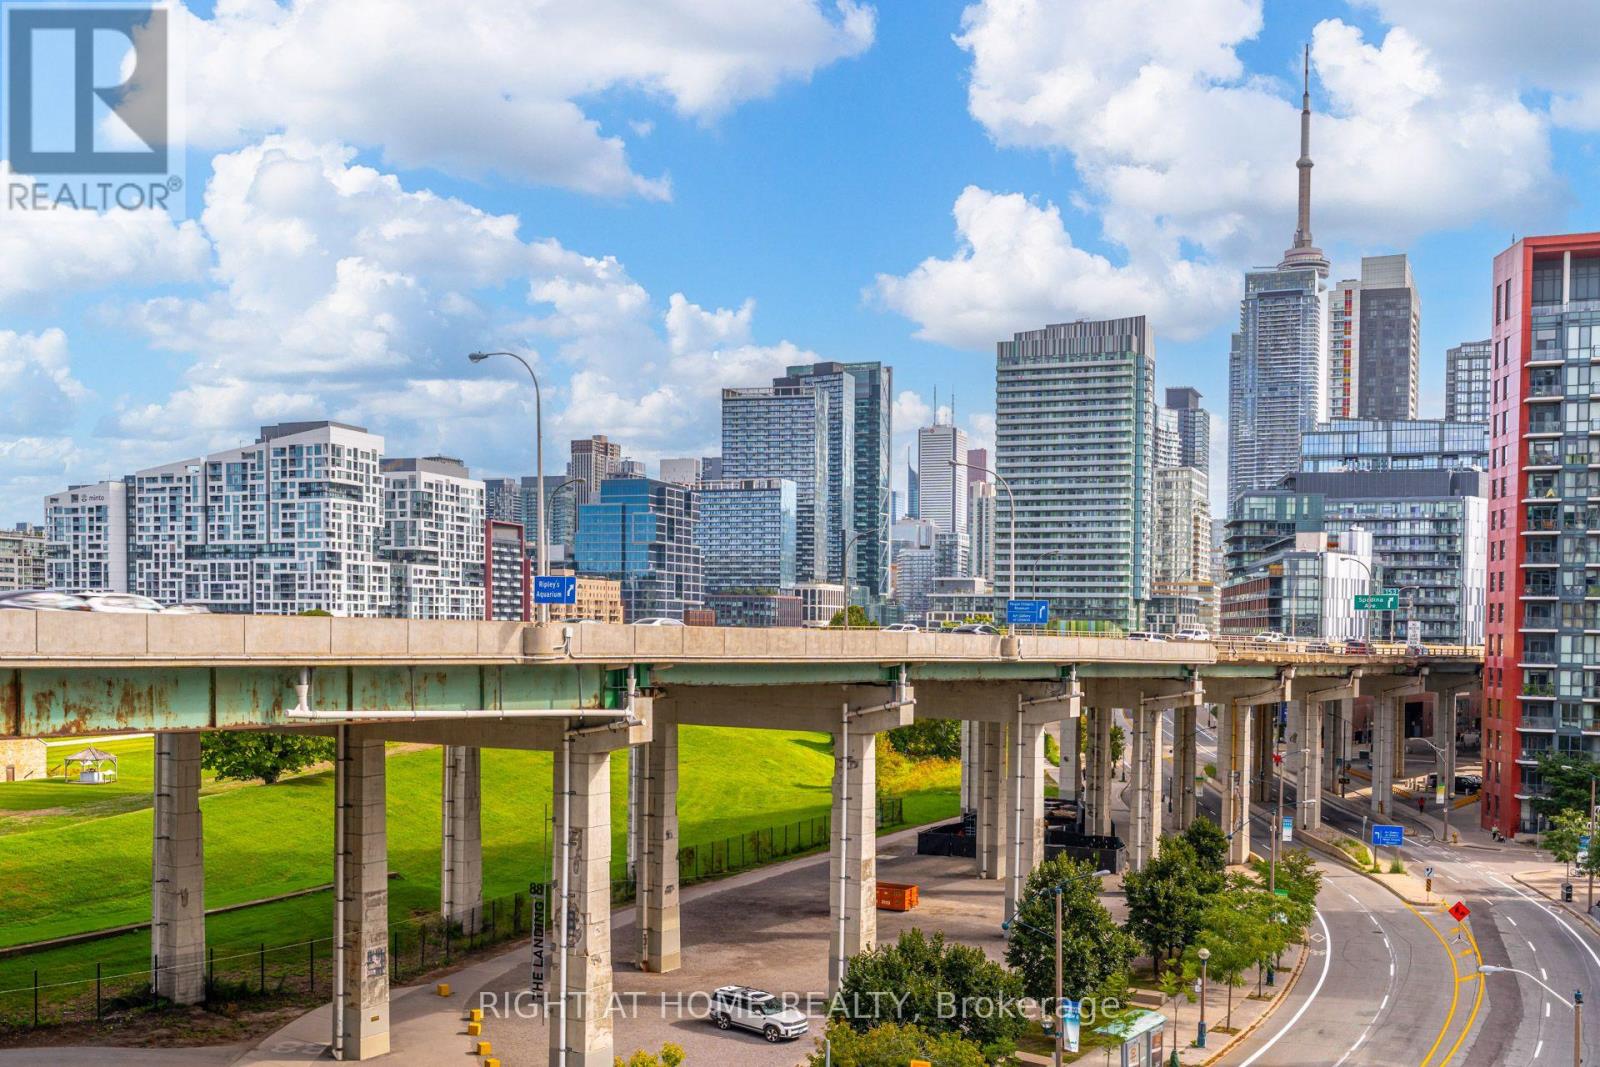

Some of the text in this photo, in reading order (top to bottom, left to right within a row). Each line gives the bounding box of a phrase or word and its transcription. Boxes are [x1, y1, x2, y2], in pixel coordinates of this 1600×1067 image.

[539, 580, 560, 589] Ripley's
[529, 882, 544, 896] 88
[532, 901, 544, 1001] THE LANDING
